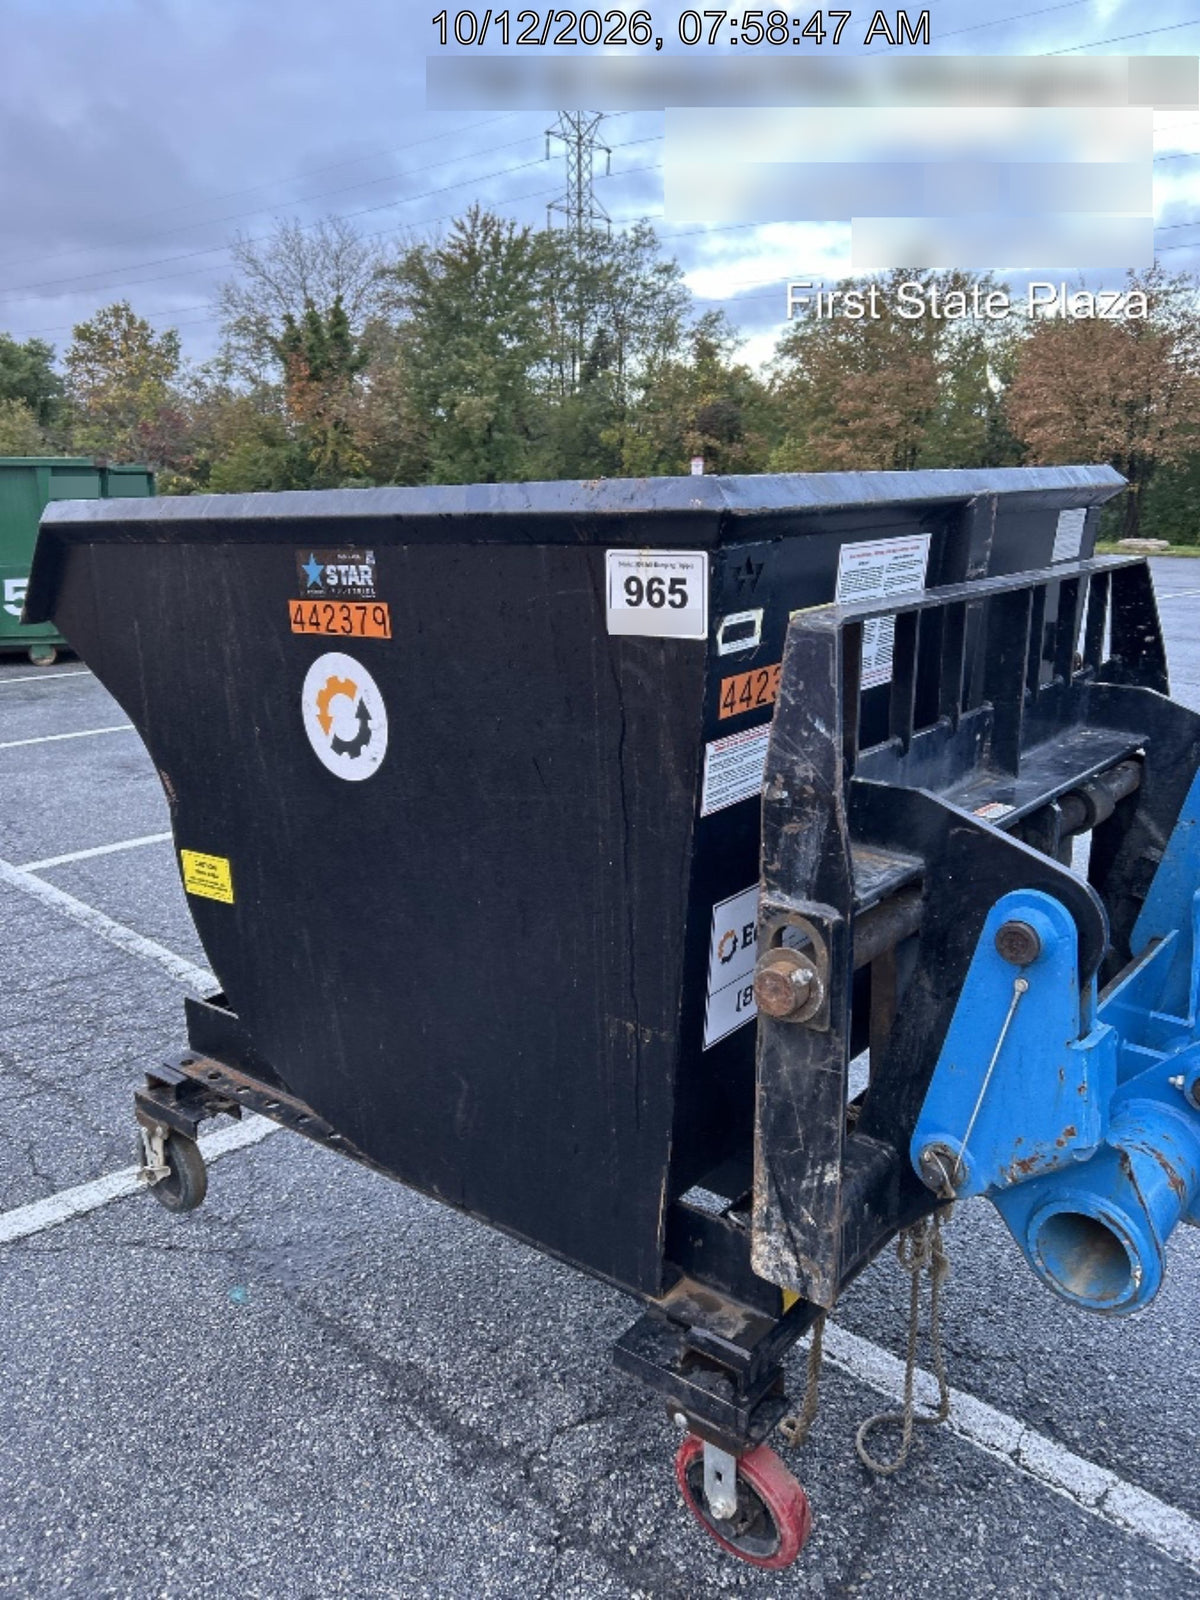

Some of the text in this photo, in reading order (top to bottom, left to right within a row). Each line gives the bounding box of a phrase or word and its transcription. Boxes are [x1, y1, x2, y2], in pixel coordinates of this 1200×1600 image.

[325, 564, 374, 586] STAR
[623, 575, 689, 609] 965
[293, 603, 388, 636] 442379
